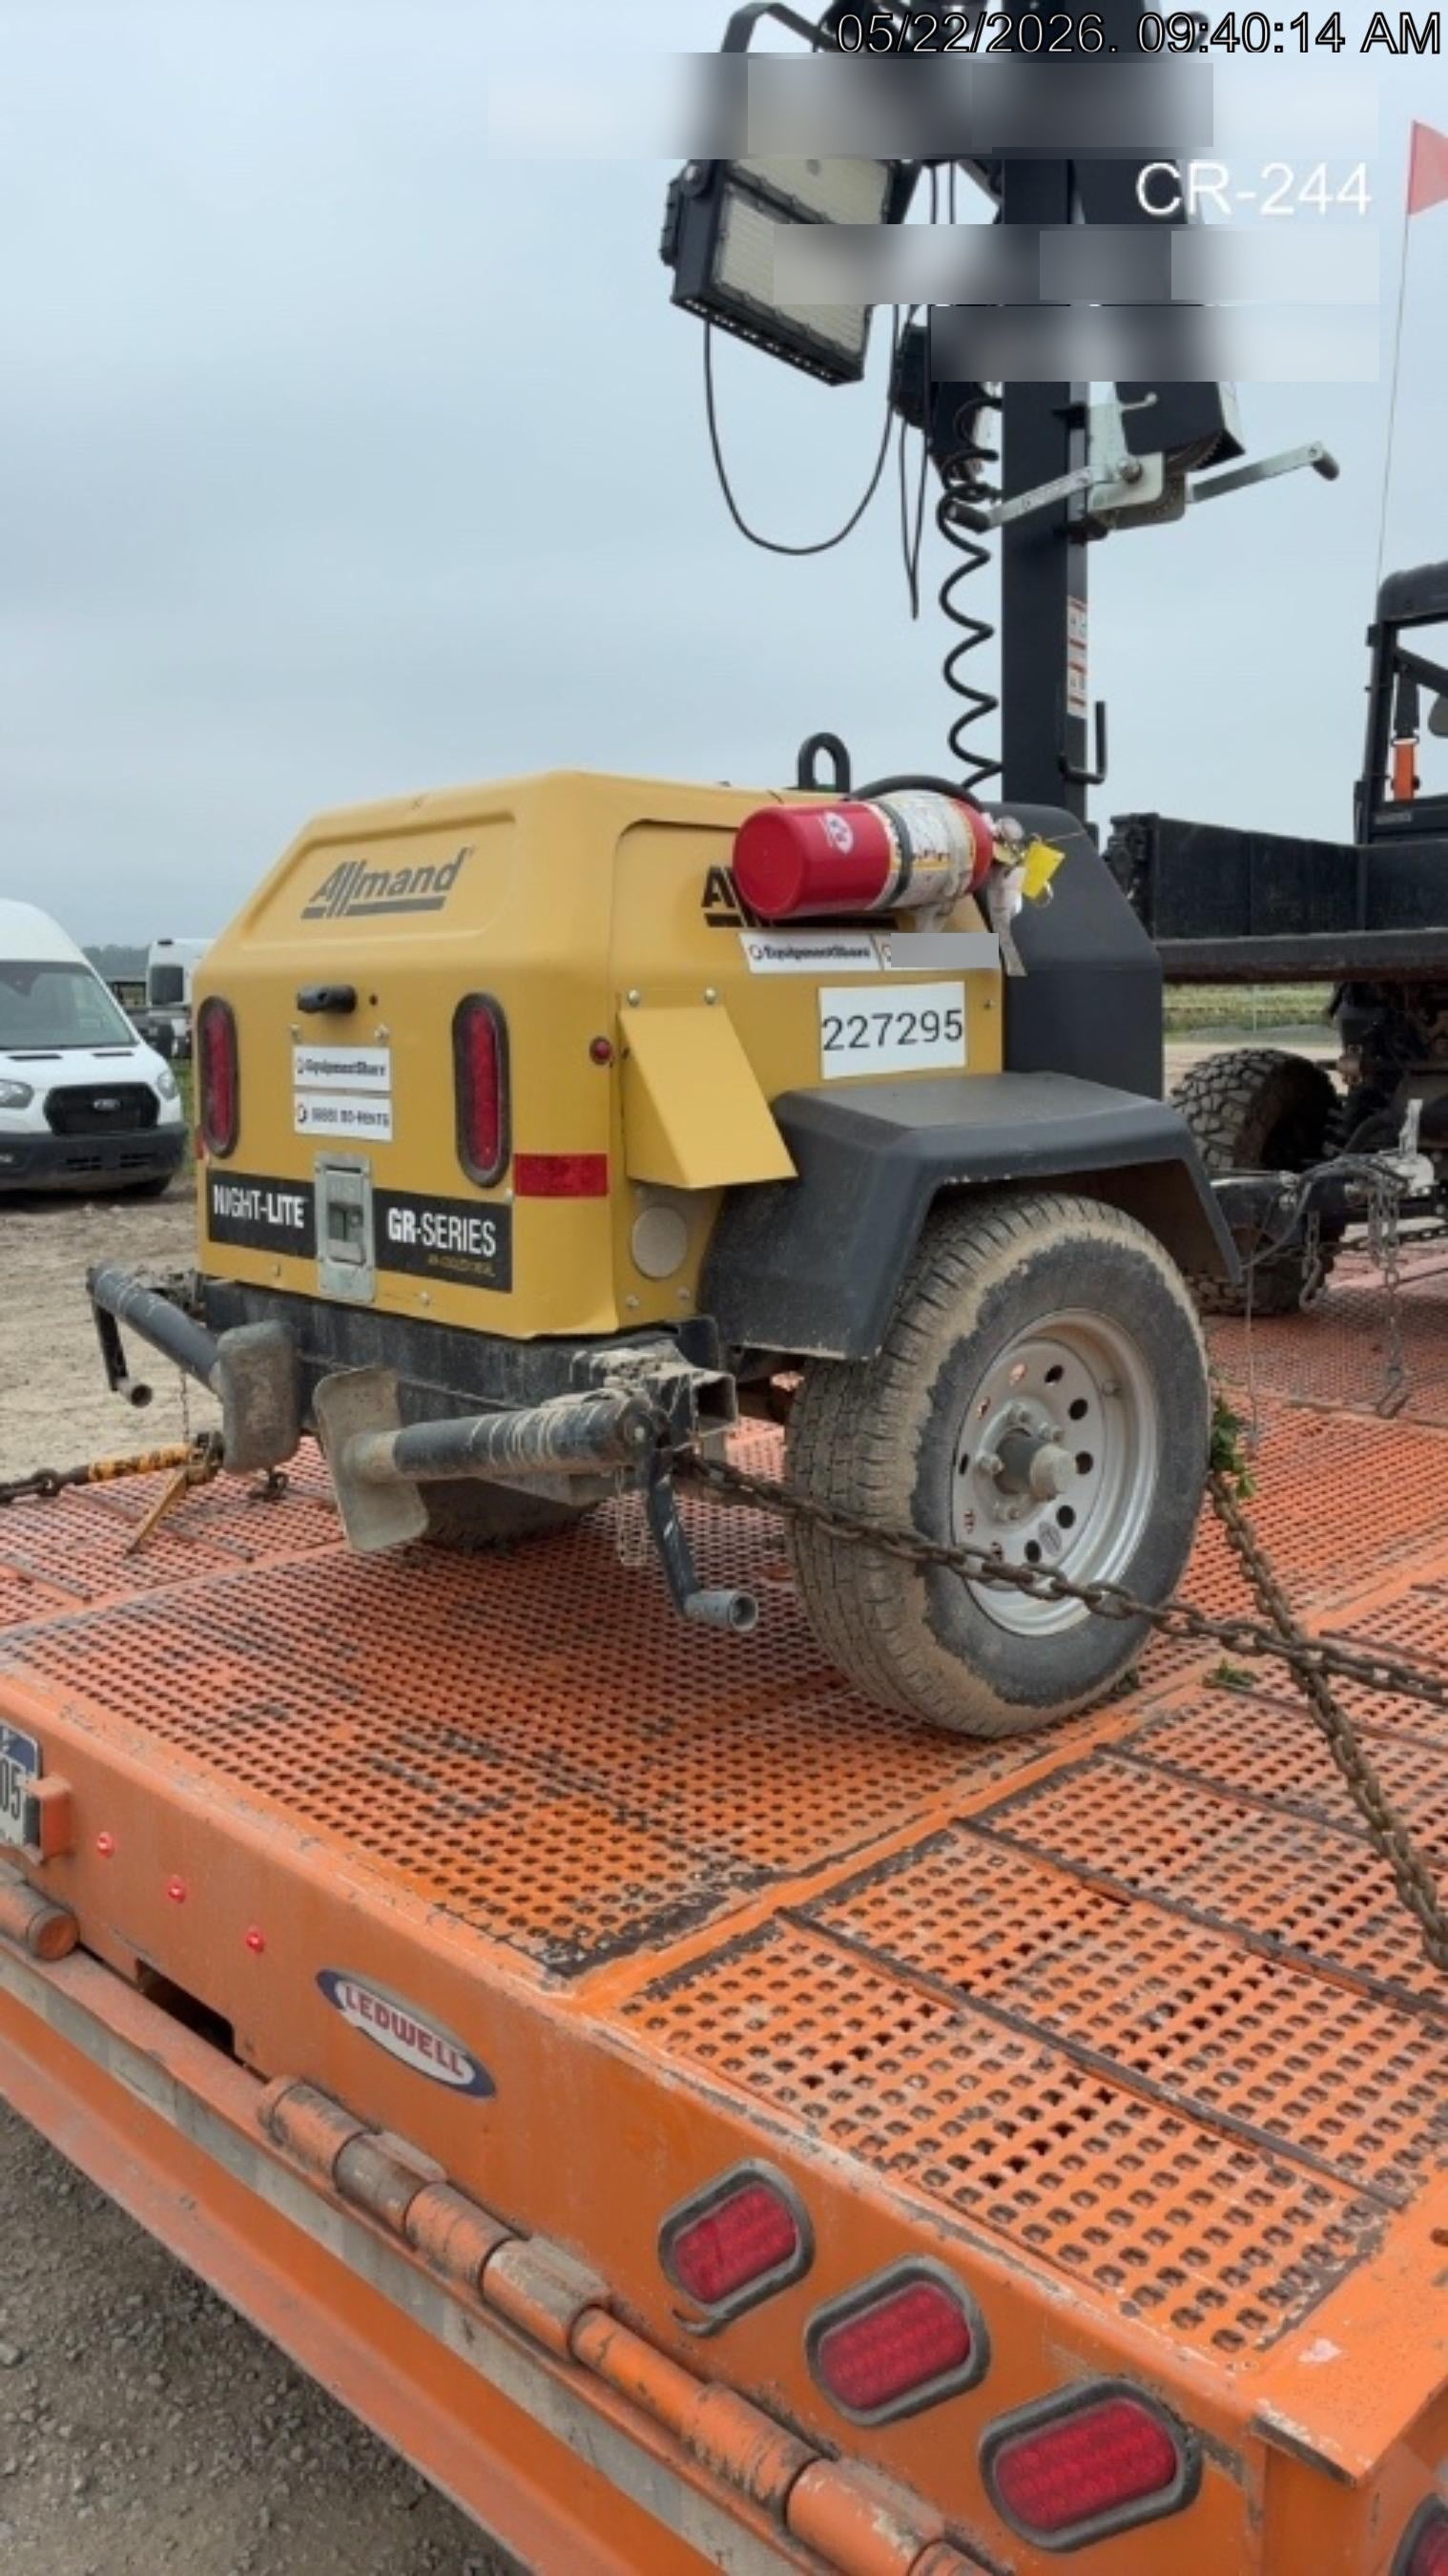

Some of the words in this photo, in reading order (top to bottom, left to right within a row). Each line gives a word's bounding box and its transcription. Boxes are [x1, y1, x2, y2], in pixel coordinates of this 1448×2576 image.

[306, 846, 469, 919] Allmand
[821, 1008, 963, 1052] 227295
[213, 1184, 304, 1229] NIGHT-LITE
[387, 1207, 496, 1257] GR-SERIES
[344, 1984, 465, 2079] LEDWELL
